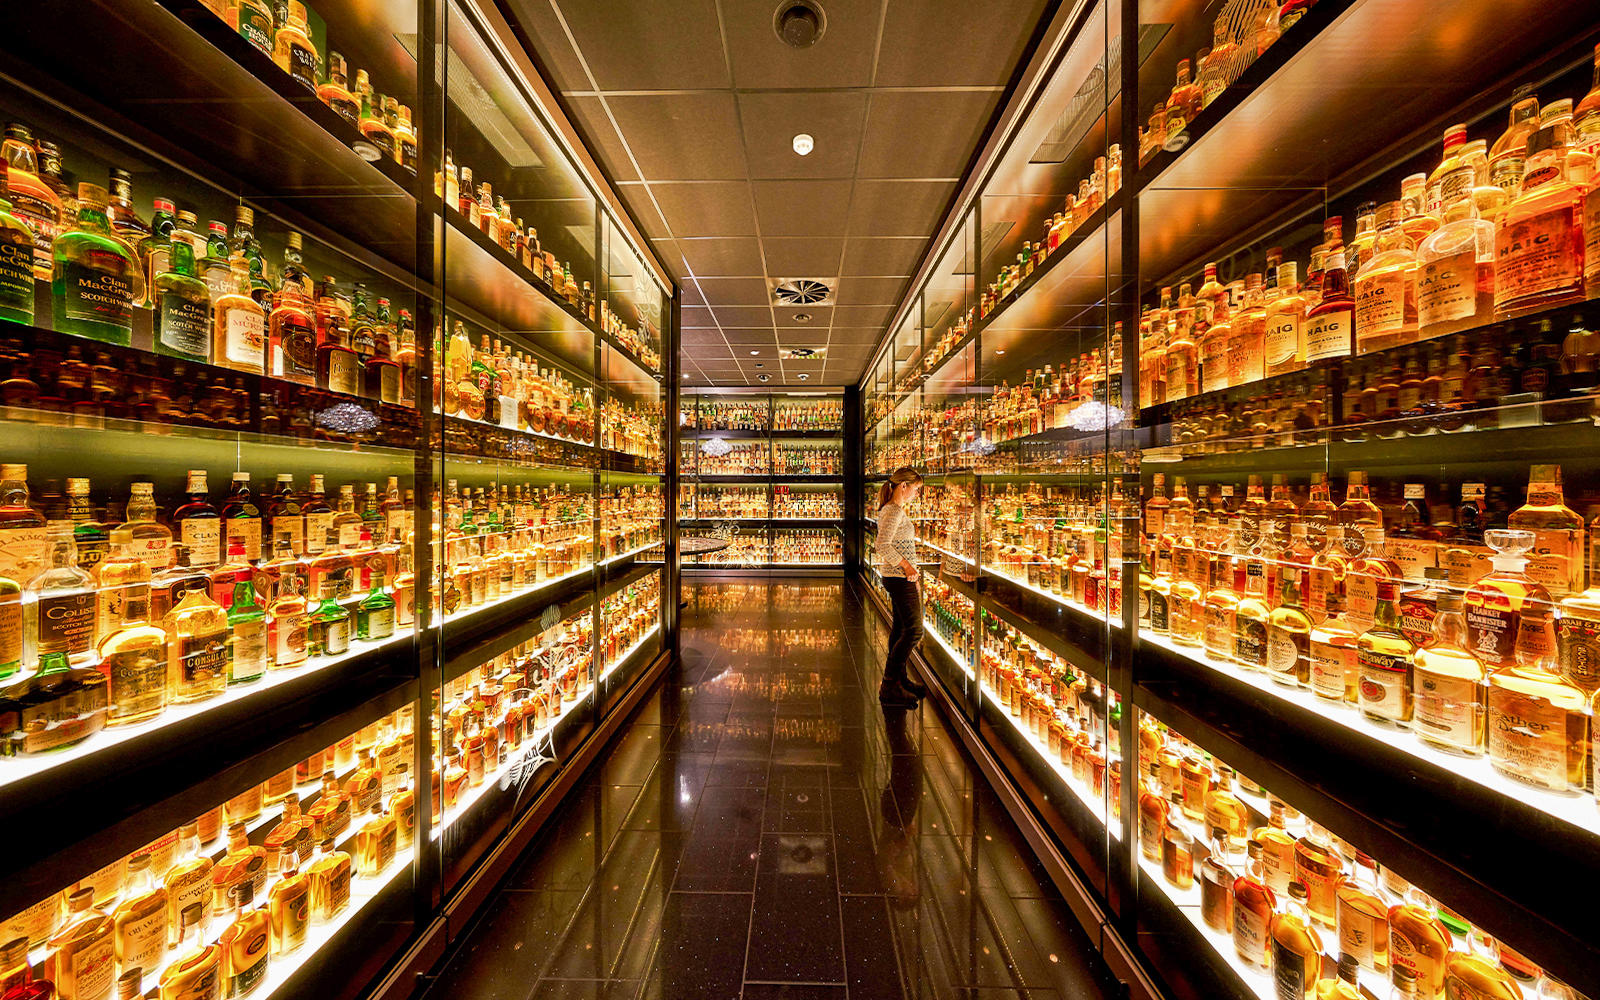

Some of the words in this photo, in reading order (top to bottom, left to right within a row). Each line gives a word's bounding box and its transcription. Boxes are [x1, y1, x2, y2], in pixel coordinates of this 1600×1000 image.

[0, 244, 30, 261] Clan
[1500, 233, 1550, 257] HAIG
[101, 275, 128, 290] Clan
[1418, 271, 1452, 288] HAIG
[80, 291, 116, 305] SCOTCH
[1356, 287, 1385, 302] HAIG
[183, 304, 206, 315] Clan
[168, 319, 193, 330] SCOTCH
[1307, 322, 1339, 337] HAIG
[1472, 605, 1501, 618] HANKEY
[52, 622, 82, 631] SCOTCH
[1467, 612, 1508, 629] BANNISTER
